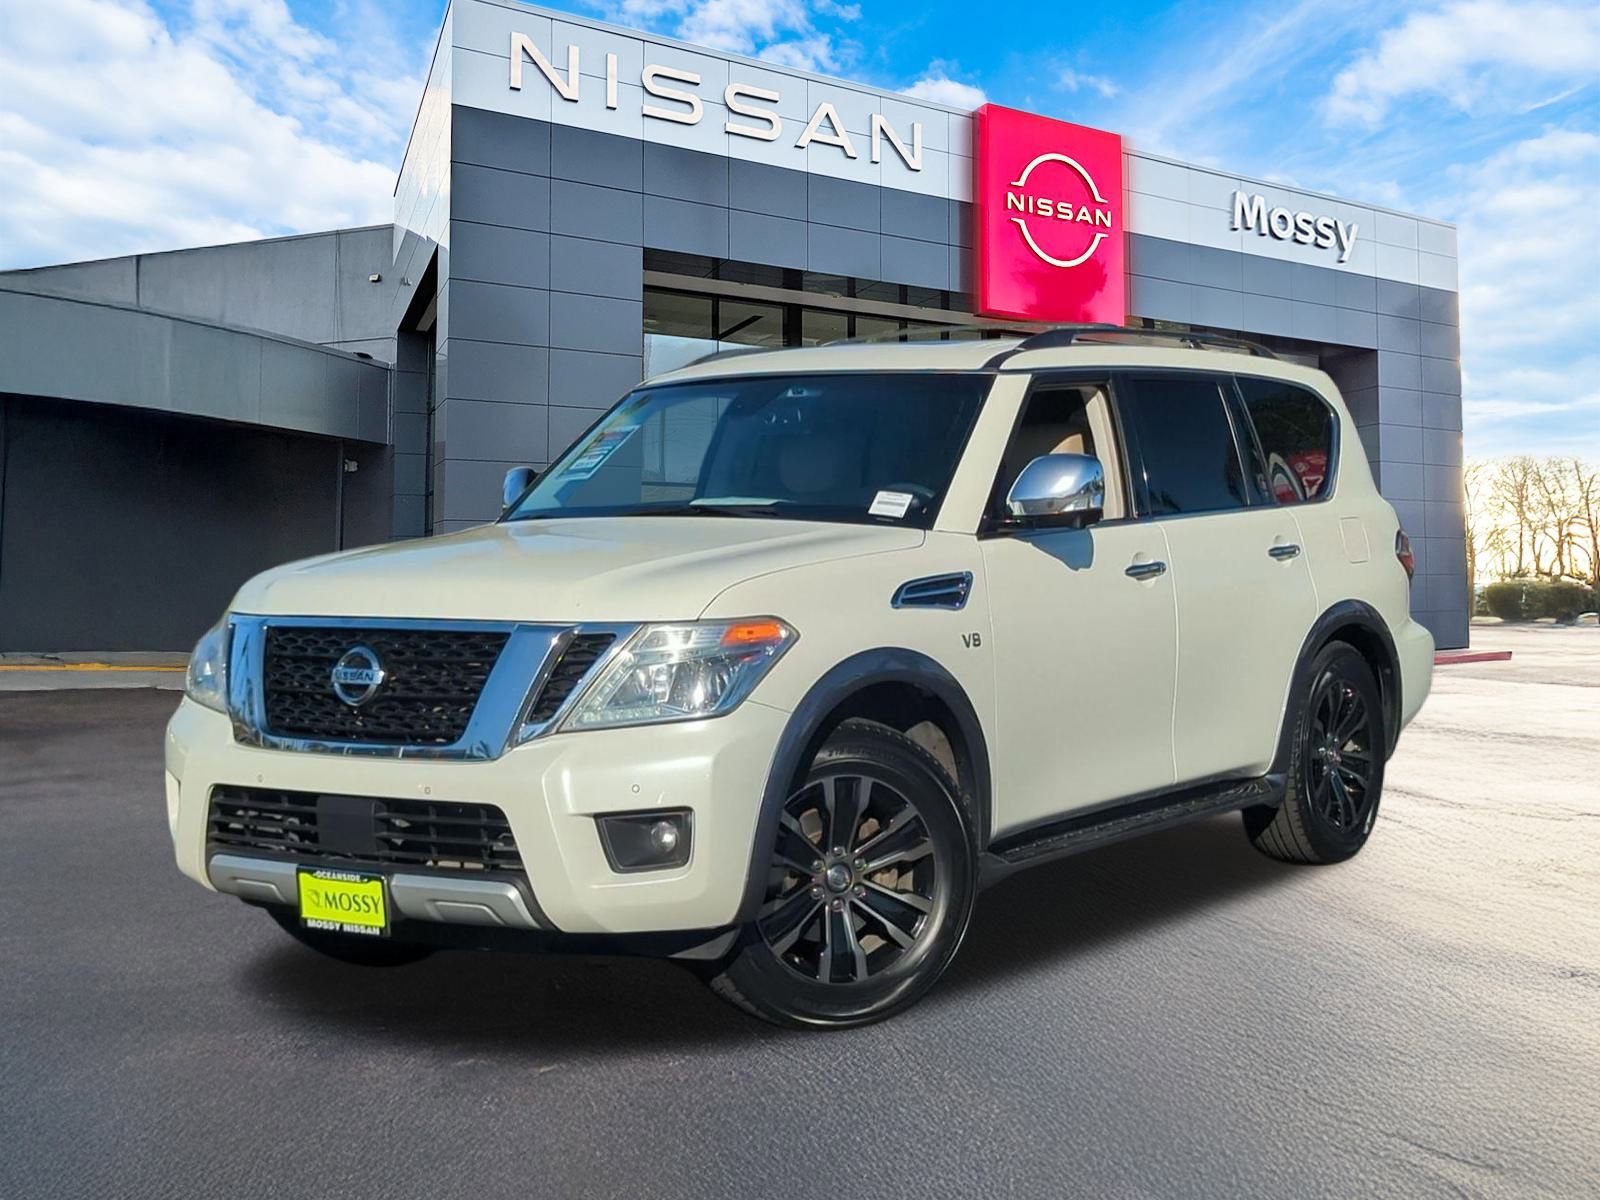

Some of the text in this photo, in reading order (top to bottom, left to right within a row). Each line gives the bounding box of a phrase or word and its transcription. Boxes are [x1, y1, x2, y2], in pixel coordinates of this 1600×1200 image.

[509, 31, 923, 171] NISSAN
[1007, 191, 1112, 228] NISSAN
[1231, 190, 1359, 263] Mossy
[315, 870, 361, 882] OCEANSIDE
[324, 891, 381, 914] MOSSY
[307, 919, 380, 935] MOSSY NISSAN
